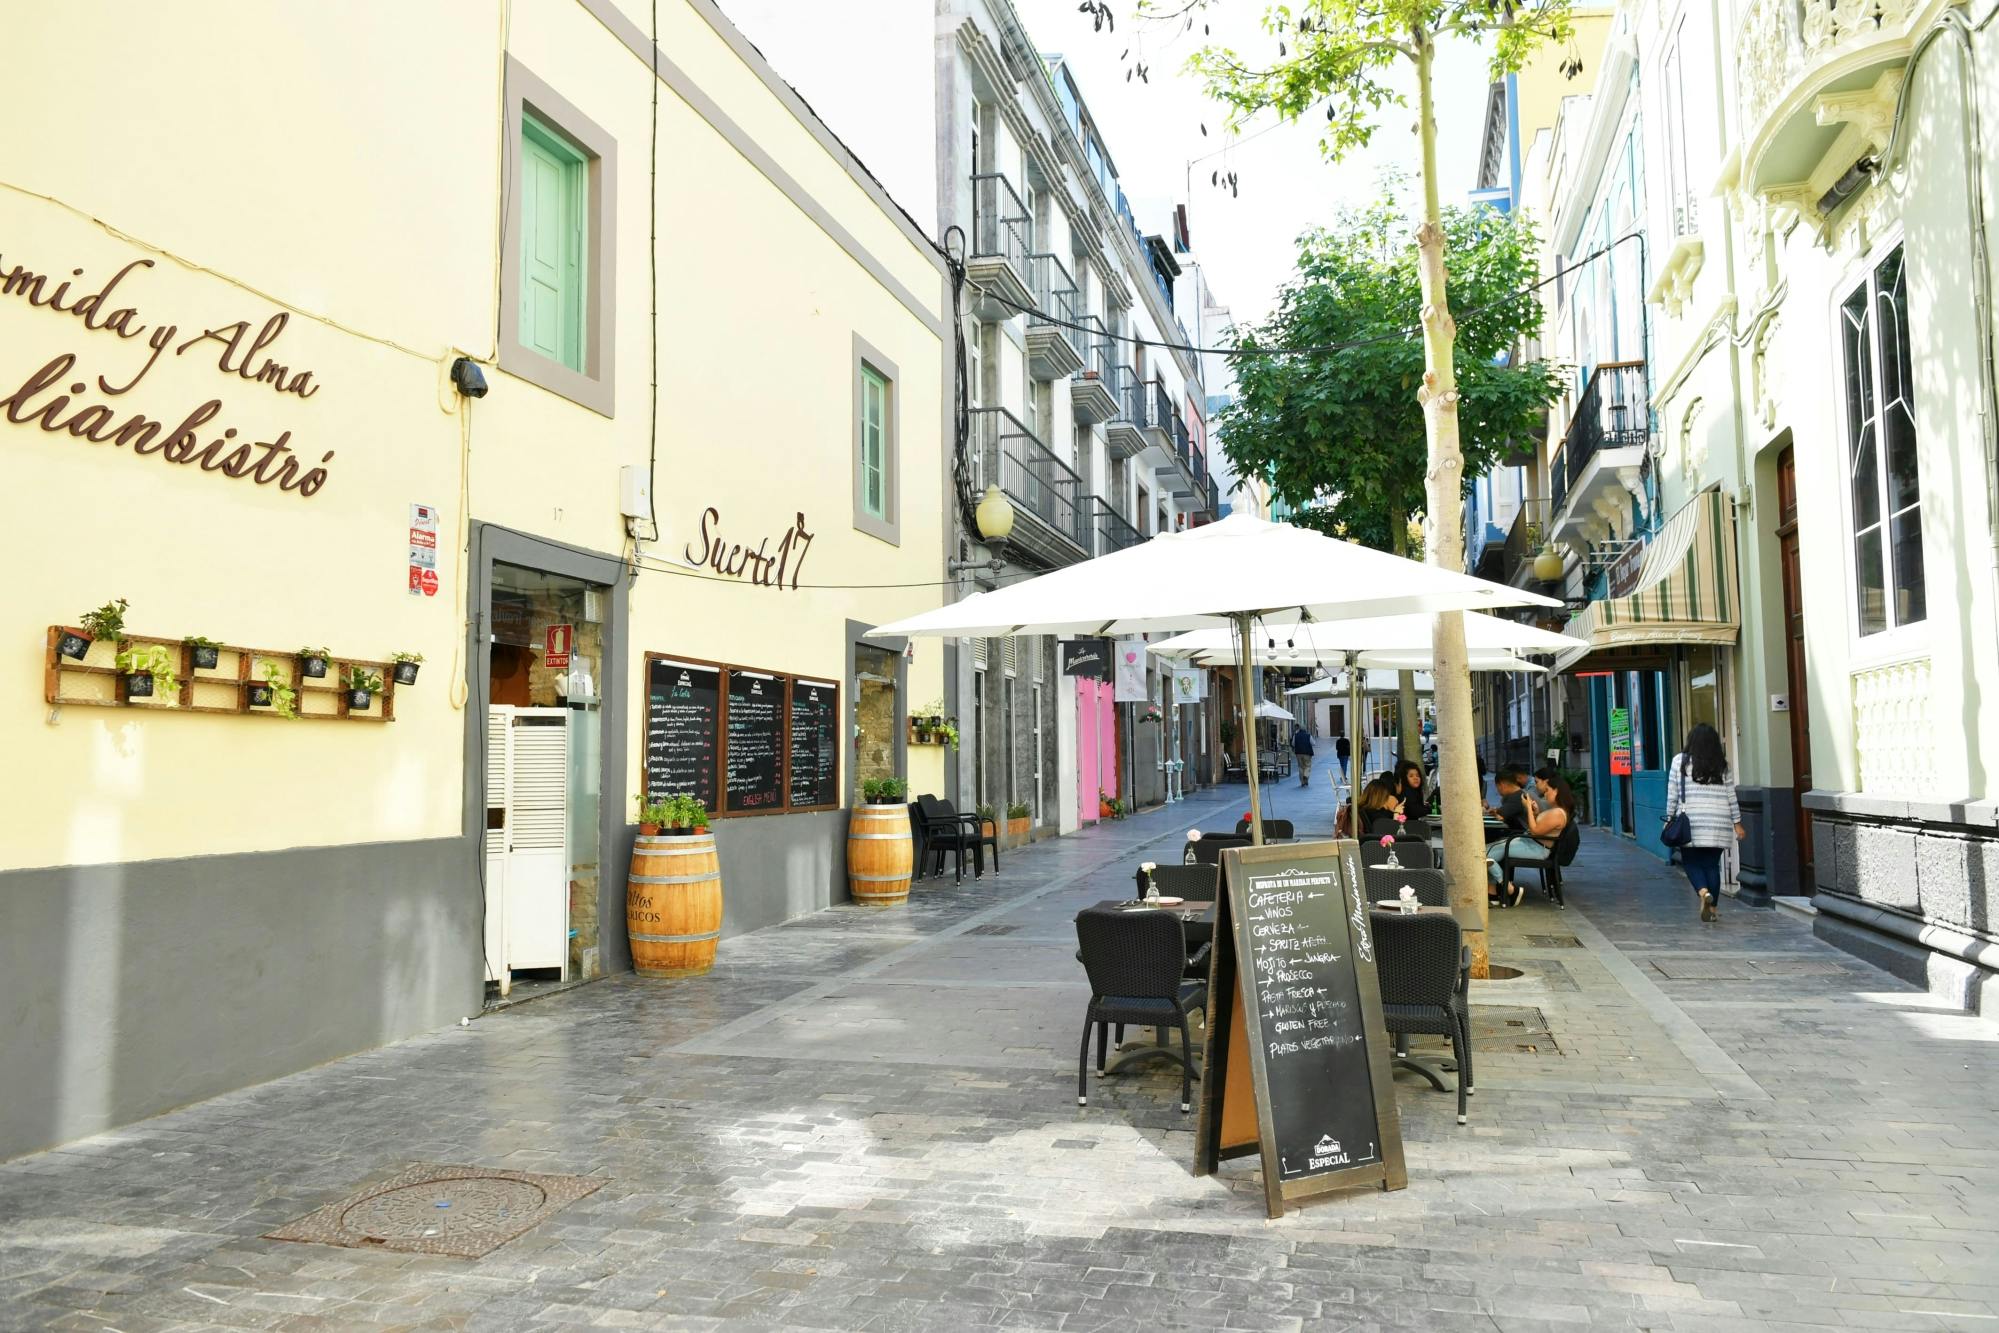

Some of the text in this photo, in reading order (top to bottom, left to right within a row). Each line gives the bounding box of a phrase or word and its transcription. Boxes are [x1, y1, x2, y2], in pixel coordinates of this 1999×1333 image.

[99, 326, 178, 395] y
[177, 312, 321, 398] Alma
[552, 507, 564, 521] 17
[411, 531, 435, 542] Alarma
[1248, 890, 1304, 908] CAFETERIA
[1264, 906, 1294, 919] VINOS
[1253, 923, 1295, 937] CERVEZA
[1256, 958, 1287, 975] MOJITO
[1276, 969, 1313, 983] PROSECCO
[1261, 986, 1315, 1004] PASTA FRESCA
[1275, 1018, 1329, 1035] GLUTEN FREE
[1269, 1042, 1299, 1059] PLATOS
[1316, 1143, 1339, 1154] DORADA
[1308, 1152, 1351, 1170] ESPECIAL
